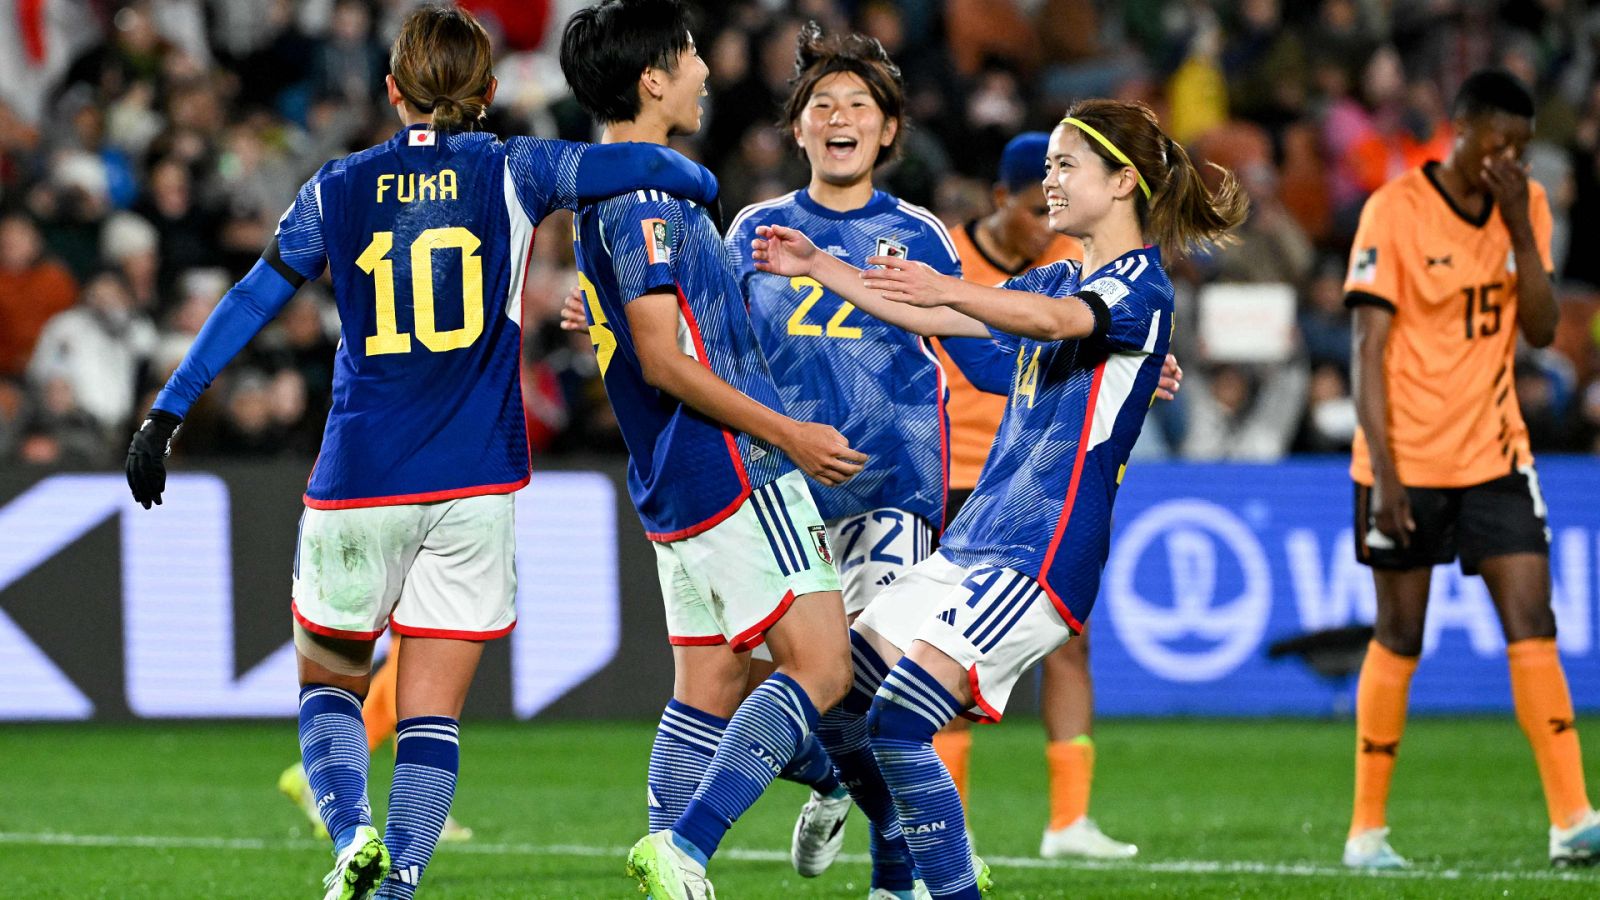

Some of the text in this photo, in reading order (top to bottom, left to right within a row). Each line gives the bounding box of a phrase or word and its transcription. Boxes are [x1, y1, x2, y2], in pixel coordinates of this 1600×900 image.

[377, 169, 458, 203] FUKA
[355, 227, 484, 356] 10
[787, 276, 862, 339] 22
[1460, 283, 1503, 340] 15
[840, 510, 904, 575] 22
[1285, 527, 1600, 657] WAN
[750, 747, 783, 777] JAP
